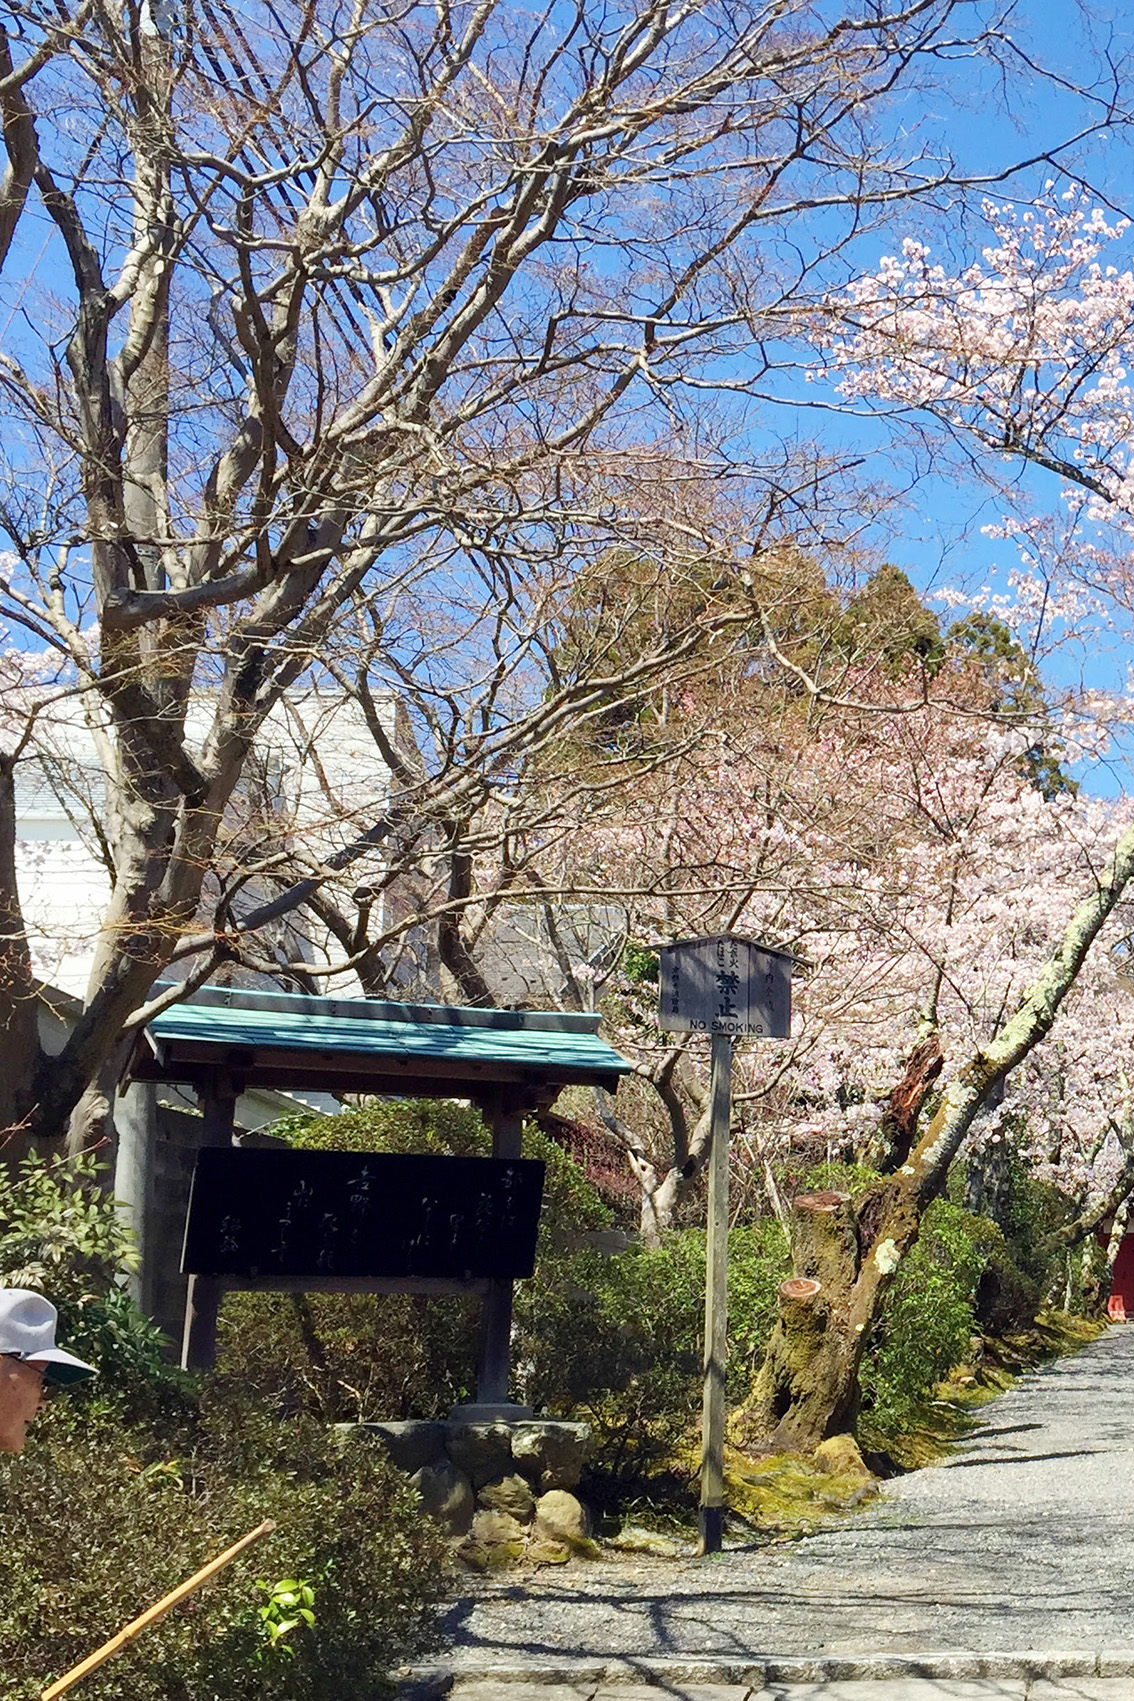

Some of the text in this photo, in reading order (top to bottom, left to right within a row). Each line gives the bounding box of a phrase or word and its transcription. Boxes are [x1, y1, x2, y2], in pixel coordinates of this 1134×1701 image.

[715, 970, 740, 1019] 禁止
[690, 1020, 763, 1034] NO SMOKING
